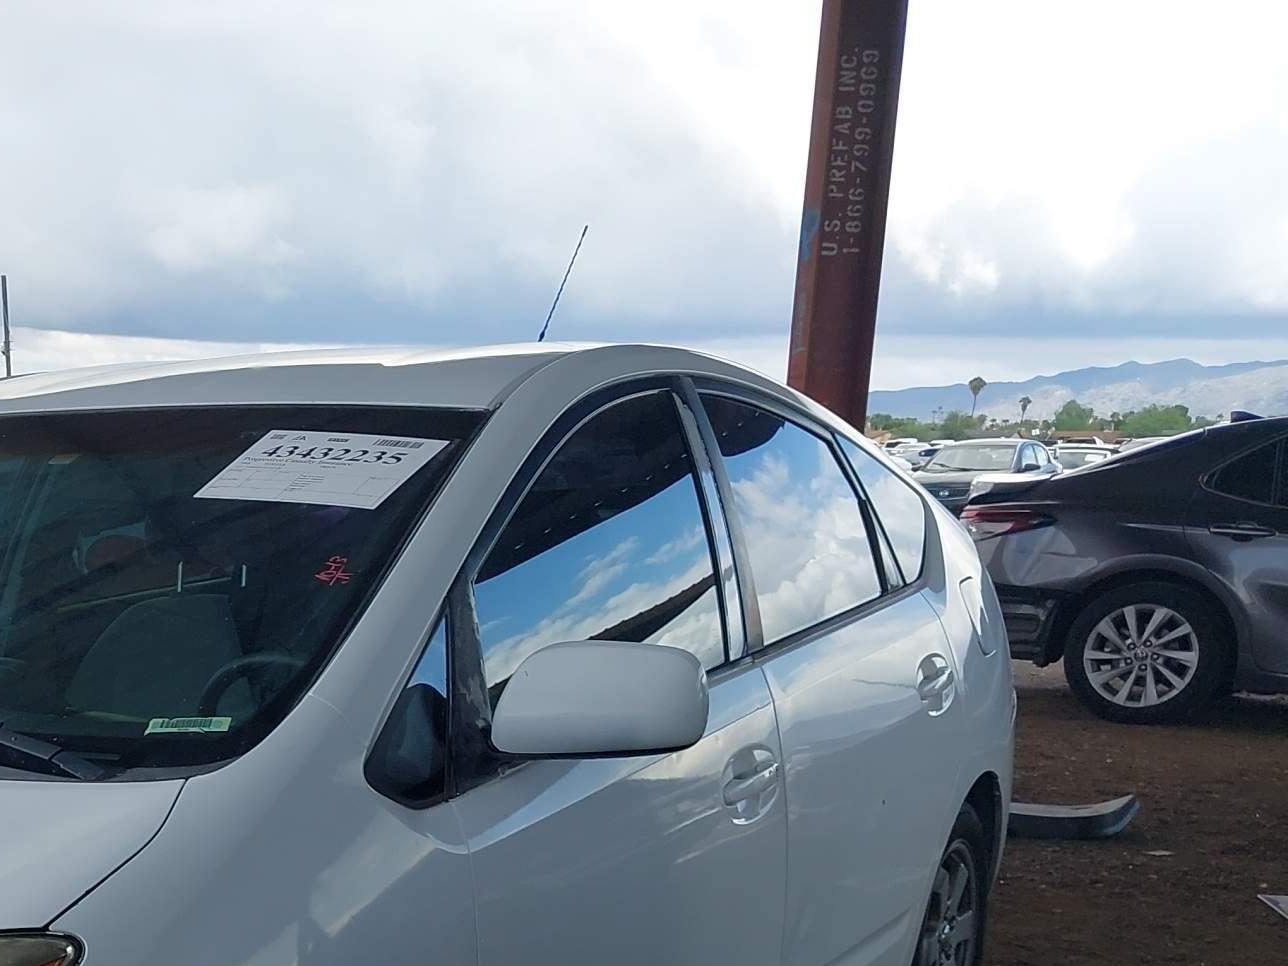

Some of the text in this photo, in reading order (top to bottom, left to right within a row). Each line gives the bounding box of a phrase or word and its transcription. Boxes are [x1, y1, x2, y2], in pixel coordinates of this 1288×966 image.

[821, 48, 858, 256] U.S. PREFAB INC.
[842, 50, 880, 255] 1-866-799-0969
[261, 444, 408, 465] 43432235
